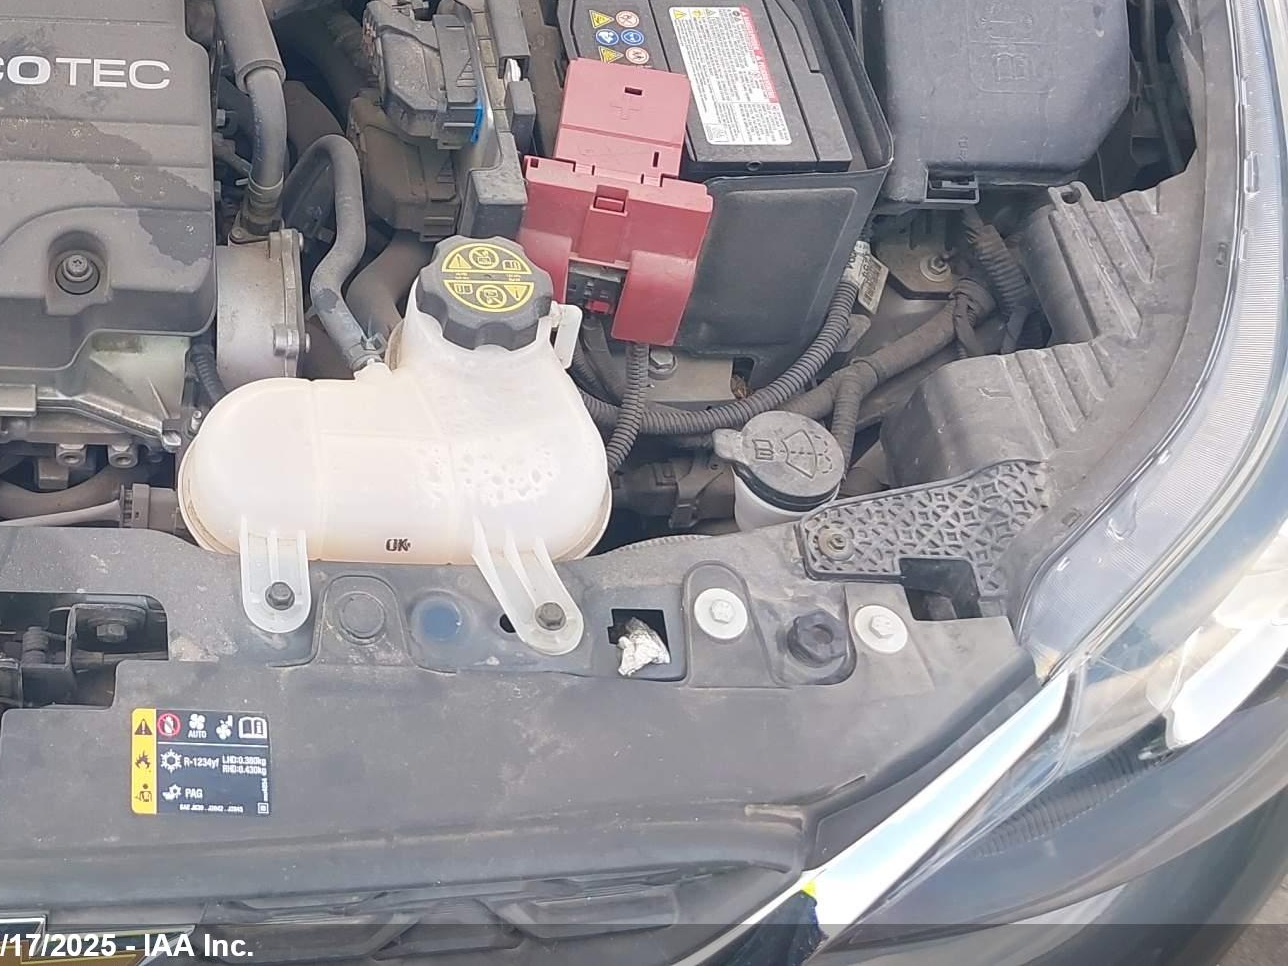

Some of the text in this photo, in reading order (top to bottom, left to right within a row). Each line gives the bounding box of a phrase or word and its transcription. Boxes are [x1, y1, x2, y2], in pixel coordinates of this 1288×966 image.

[188, 730, 206, 738] AUTO
[183, 756, 220, 769] R-1234yf
[185, 788, 203, 799] PAG
